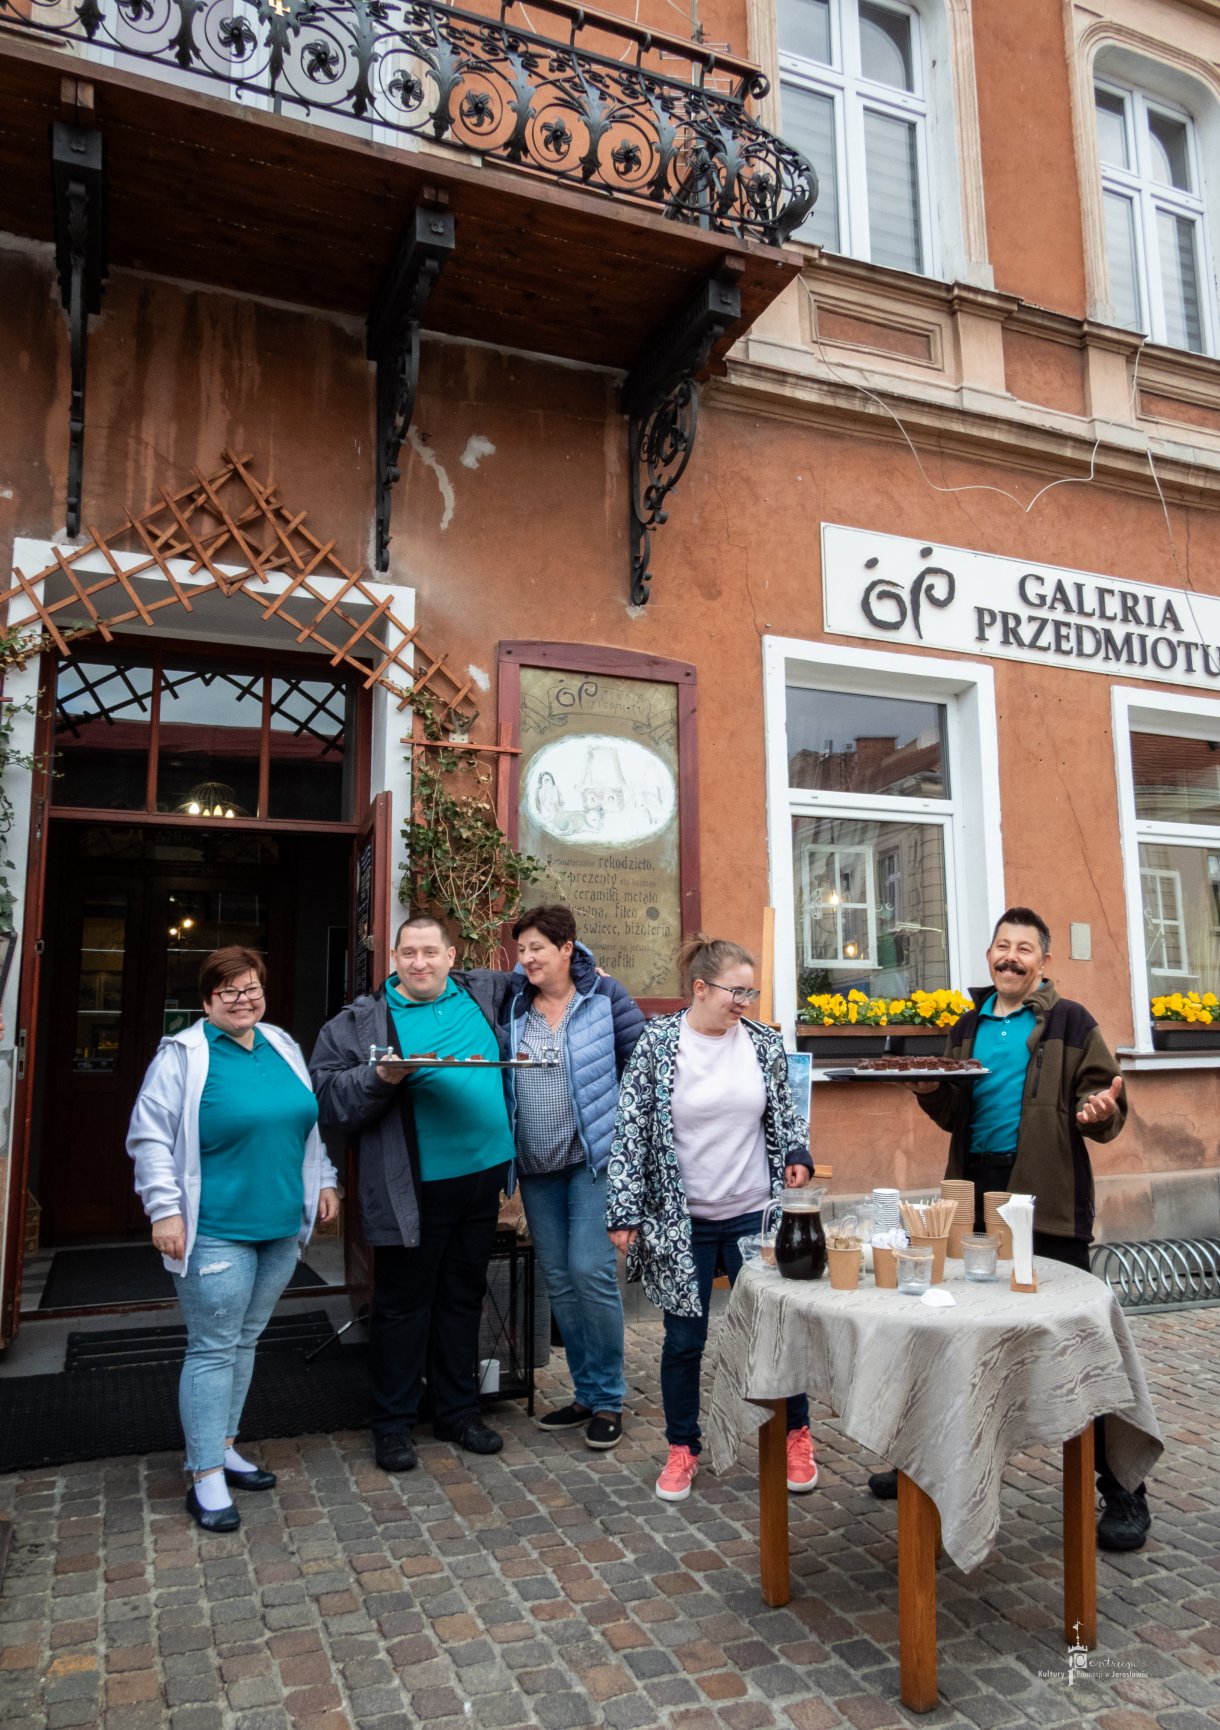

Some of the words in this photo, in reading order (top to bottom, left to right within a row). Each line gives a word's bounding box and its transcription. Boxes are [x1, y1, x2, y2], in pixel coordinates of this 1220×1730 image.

[1018, 572, 1185, 633] GALERIA
[569, 872, 617, 889] prezenty
[599, 951, 635, 969] grafiki
